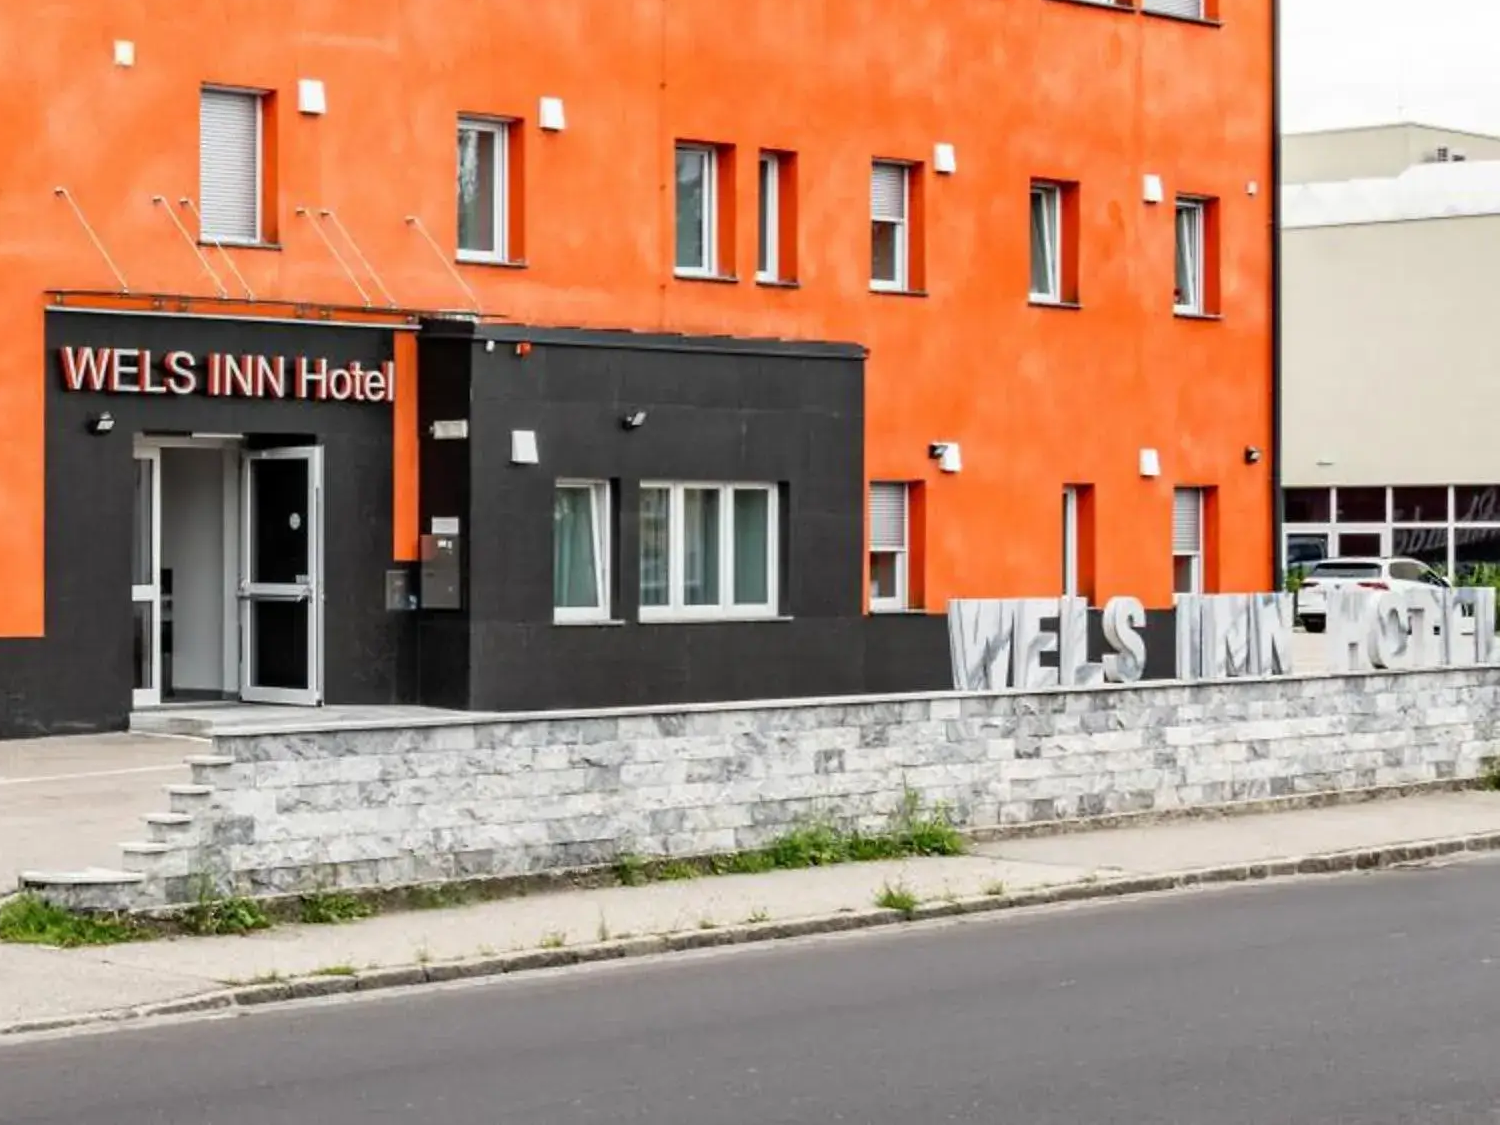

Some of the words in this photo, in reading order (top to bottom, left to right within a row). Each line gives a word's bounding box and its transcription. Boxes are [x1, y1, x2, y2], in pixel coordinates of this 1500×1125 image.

[59, 345, 197, 395] WELS
[207, 351, 286, 398] INN
[294, 355, 395, 402] Hotel
[947, 595, 1147, 691] WELS
[1175, 592, 1293, 680] INN
[1325, 586, 1500, 672] HOTEL
